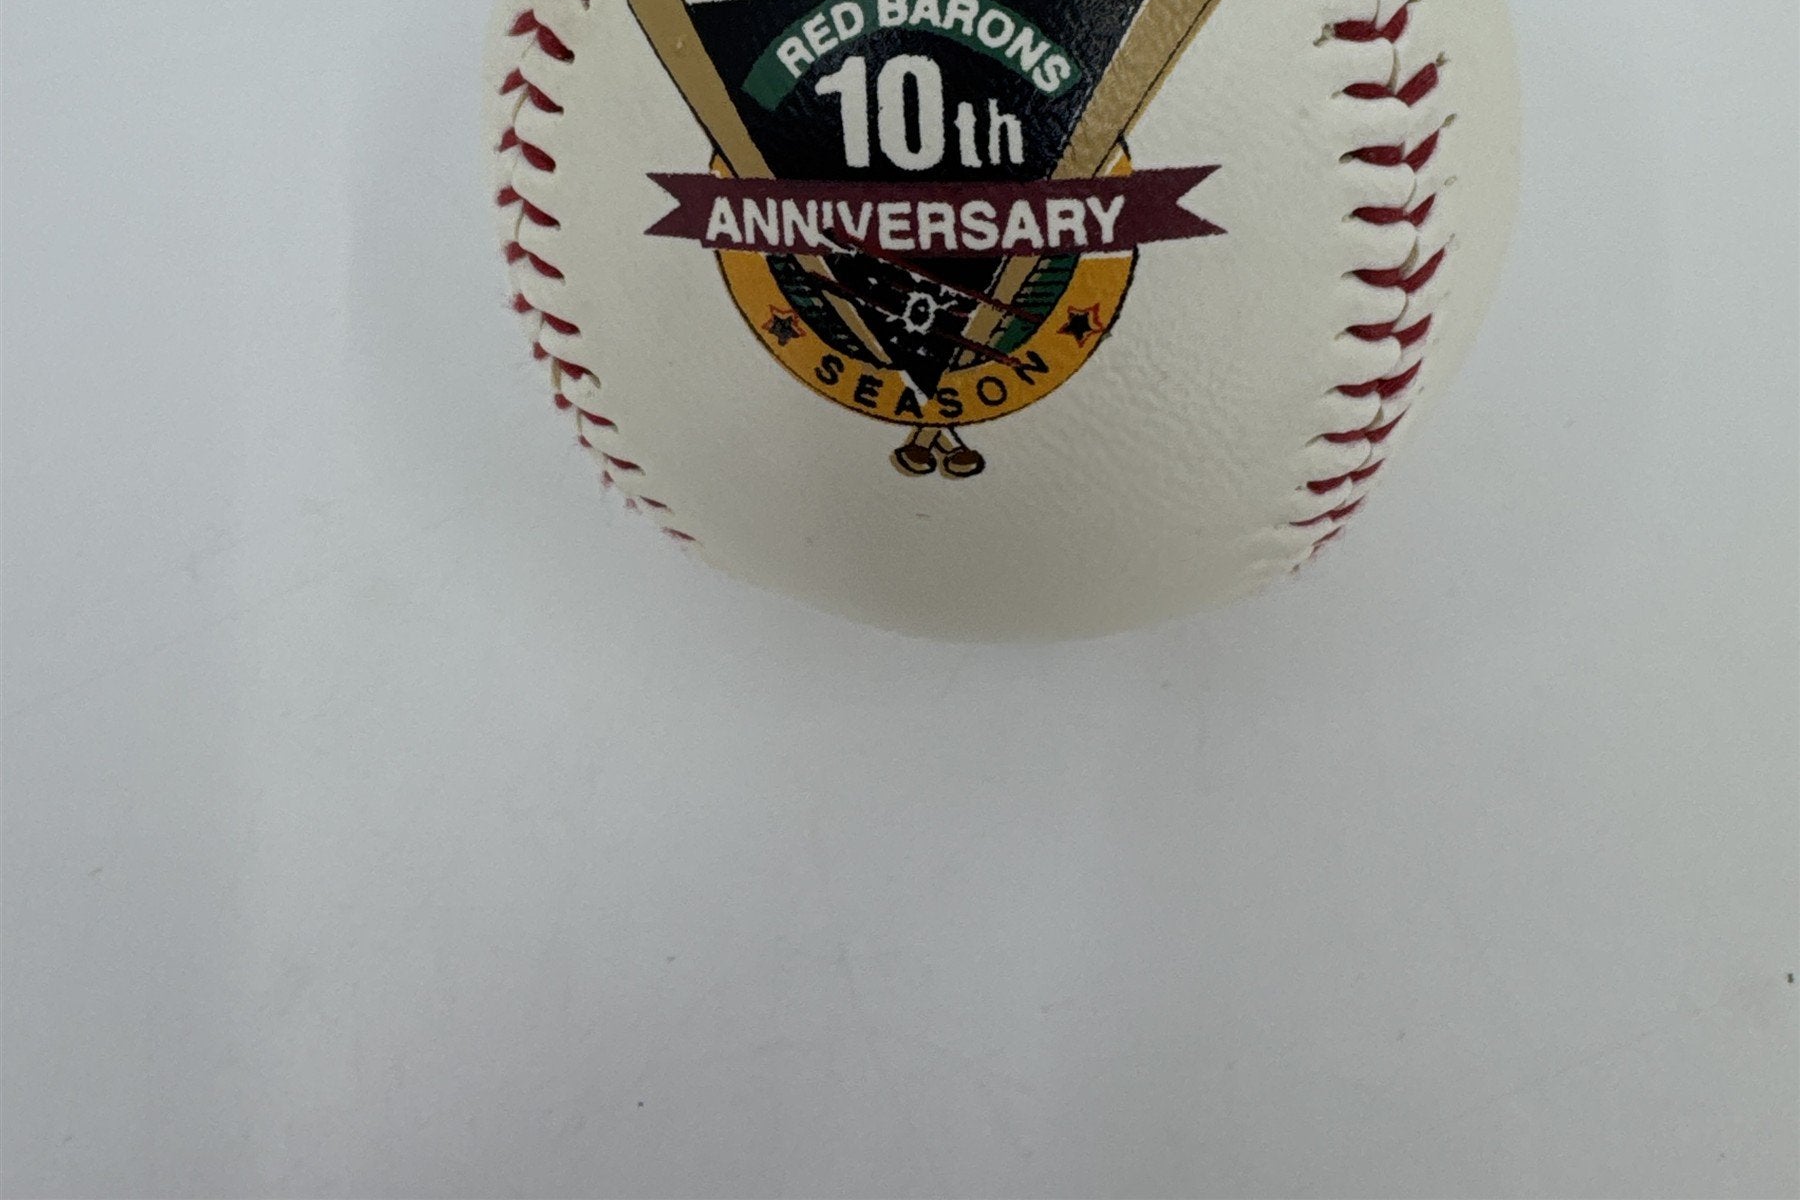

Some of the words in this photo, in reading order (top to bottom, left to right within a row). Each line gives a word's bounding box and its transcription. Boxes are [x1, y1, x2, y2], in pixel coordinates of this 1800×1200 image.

[776, 0, 865, 79] RED
[814, 53, 1025, 171] 10th
[706, 194, 1127, 250] ANNIVERSARY
[814, 347, 1051, 420] SEASON
